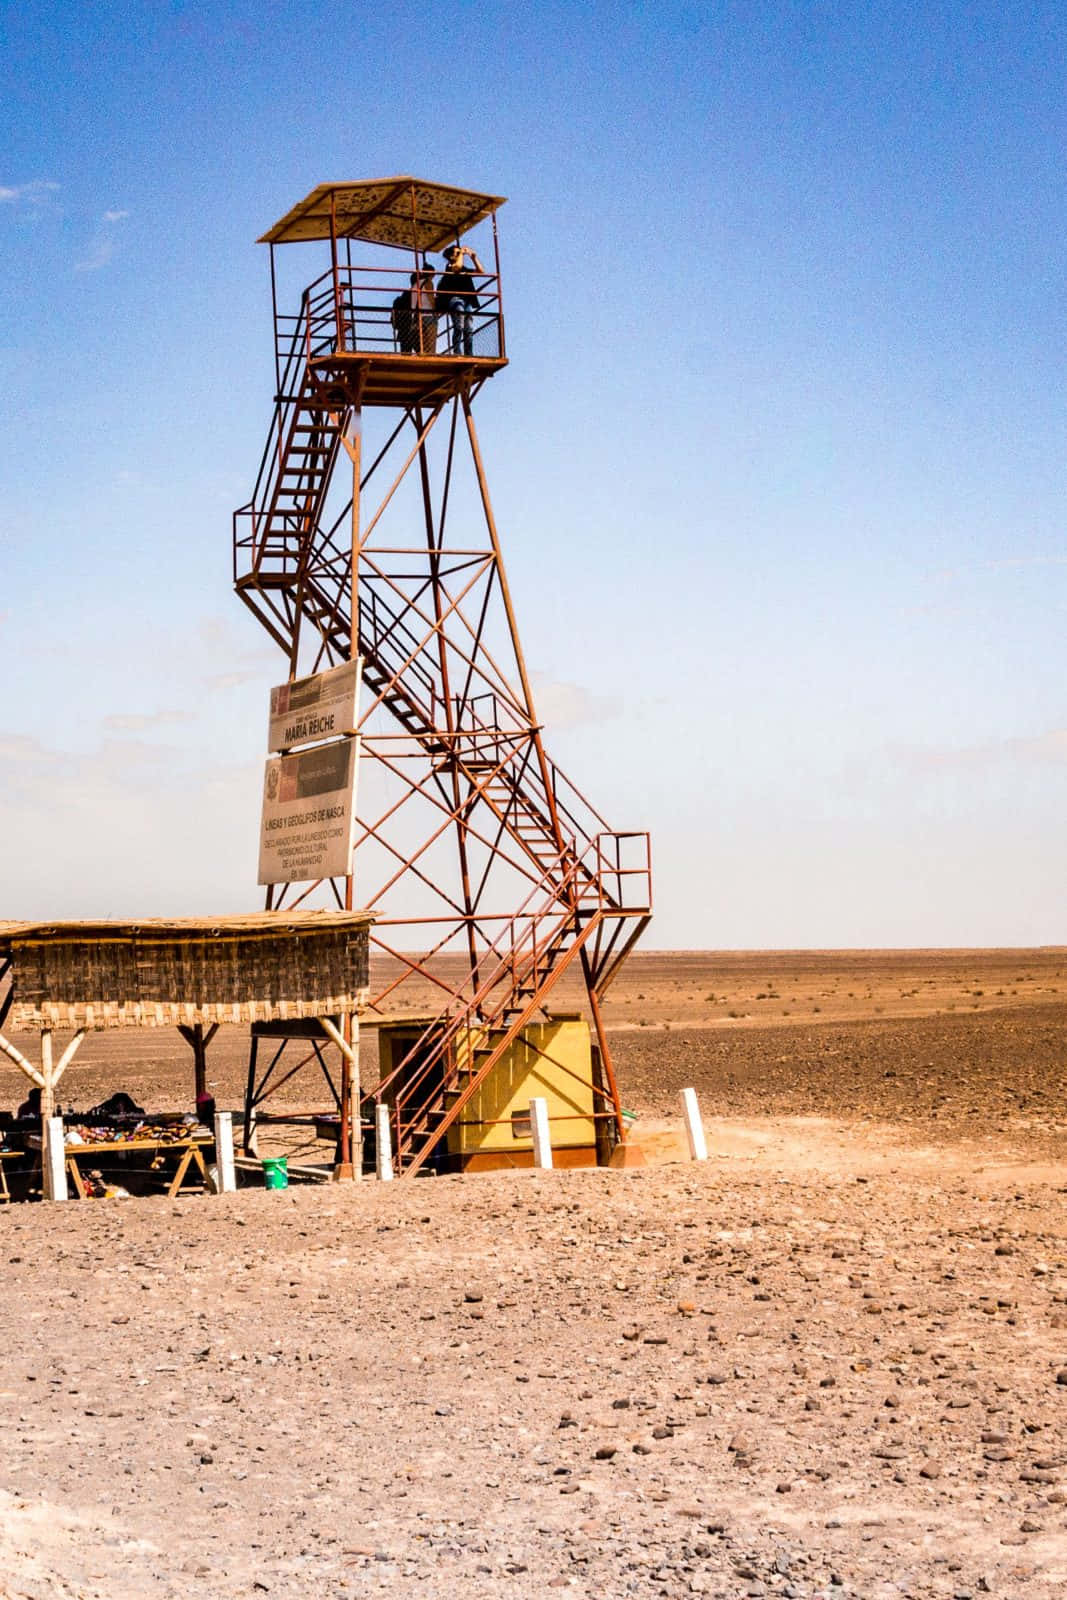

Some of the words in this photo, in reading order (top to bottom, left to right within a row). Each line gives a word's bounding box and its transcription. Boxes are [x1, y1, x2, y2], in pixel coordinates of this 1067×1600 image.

[309, 715, 334, 735] REICHE
[318, 809, 325, 821] DE
[326, 805, 345, 819] NASCA
[282, 859, 289, 868] DE
